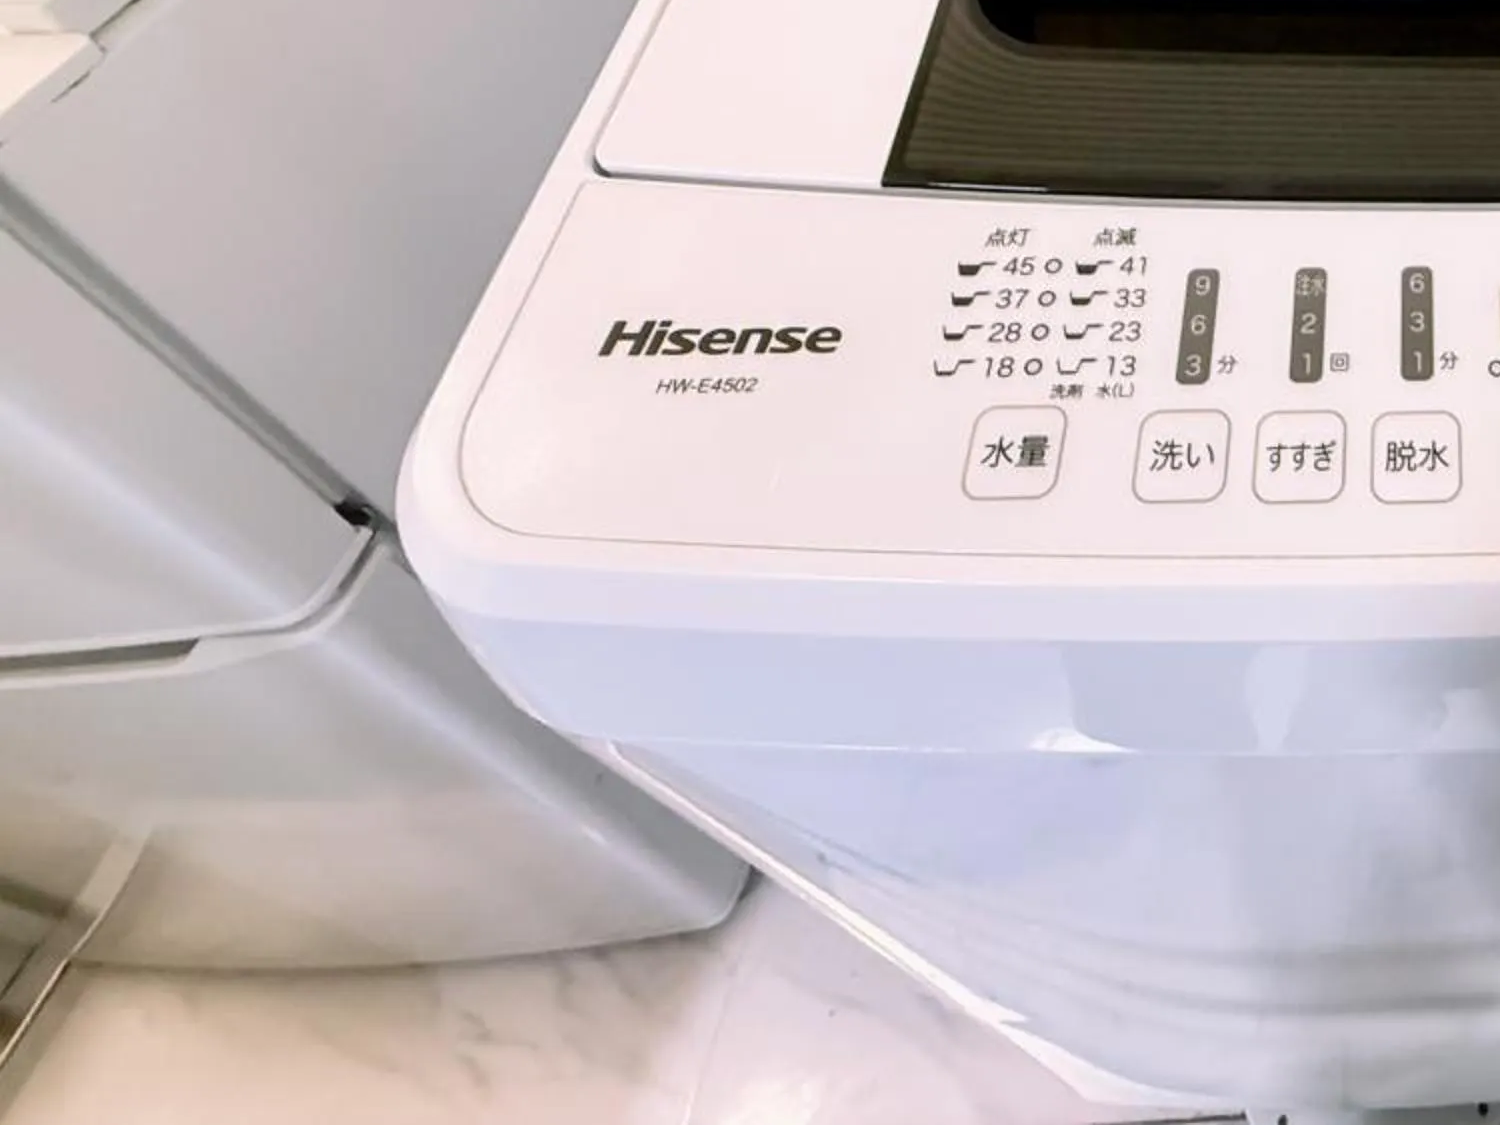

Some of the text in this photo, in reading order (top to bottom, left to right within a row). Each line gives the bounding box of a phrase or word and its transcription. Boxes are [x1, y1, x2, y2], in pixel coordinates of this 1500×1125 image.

[985, 227, 1031, 247] 点灯
[1003, 256, 1037, 276] 45
[1119, 256, 1148, 276] 41
[1195, 275, 1210, 295] 9
[1409, 273, 1425, 293] 6
[995, 289, 1030, 309] 37
[1113, 288, 1147, 308] 33
[987, 322, 1023, 343] 28
[1107, 321, 1142, 342] 23
[1190, 314, 1207, 334] 6
[1301, 312, 1317, 334] 2
[1409, 312, 1425, 332] 3
[598, 320, 842, 357] Hisense
[984, 356, 1016, 378] 18
[1107, 355, 1138, 377] 13
[1184, 354, 1202, 376] 3
[1302, 353, 1311, 374] 1
[1413, 352, 1422, 373] 1
[655, 378, 758, 394] HW-E4502
[980, 435, 1051, 469] 水量
[1149, 440, 1216, 471] 洗い
[1266, 440, 1337, 472] すすぎ
[1385, 440, 1450, 472] 脱水
